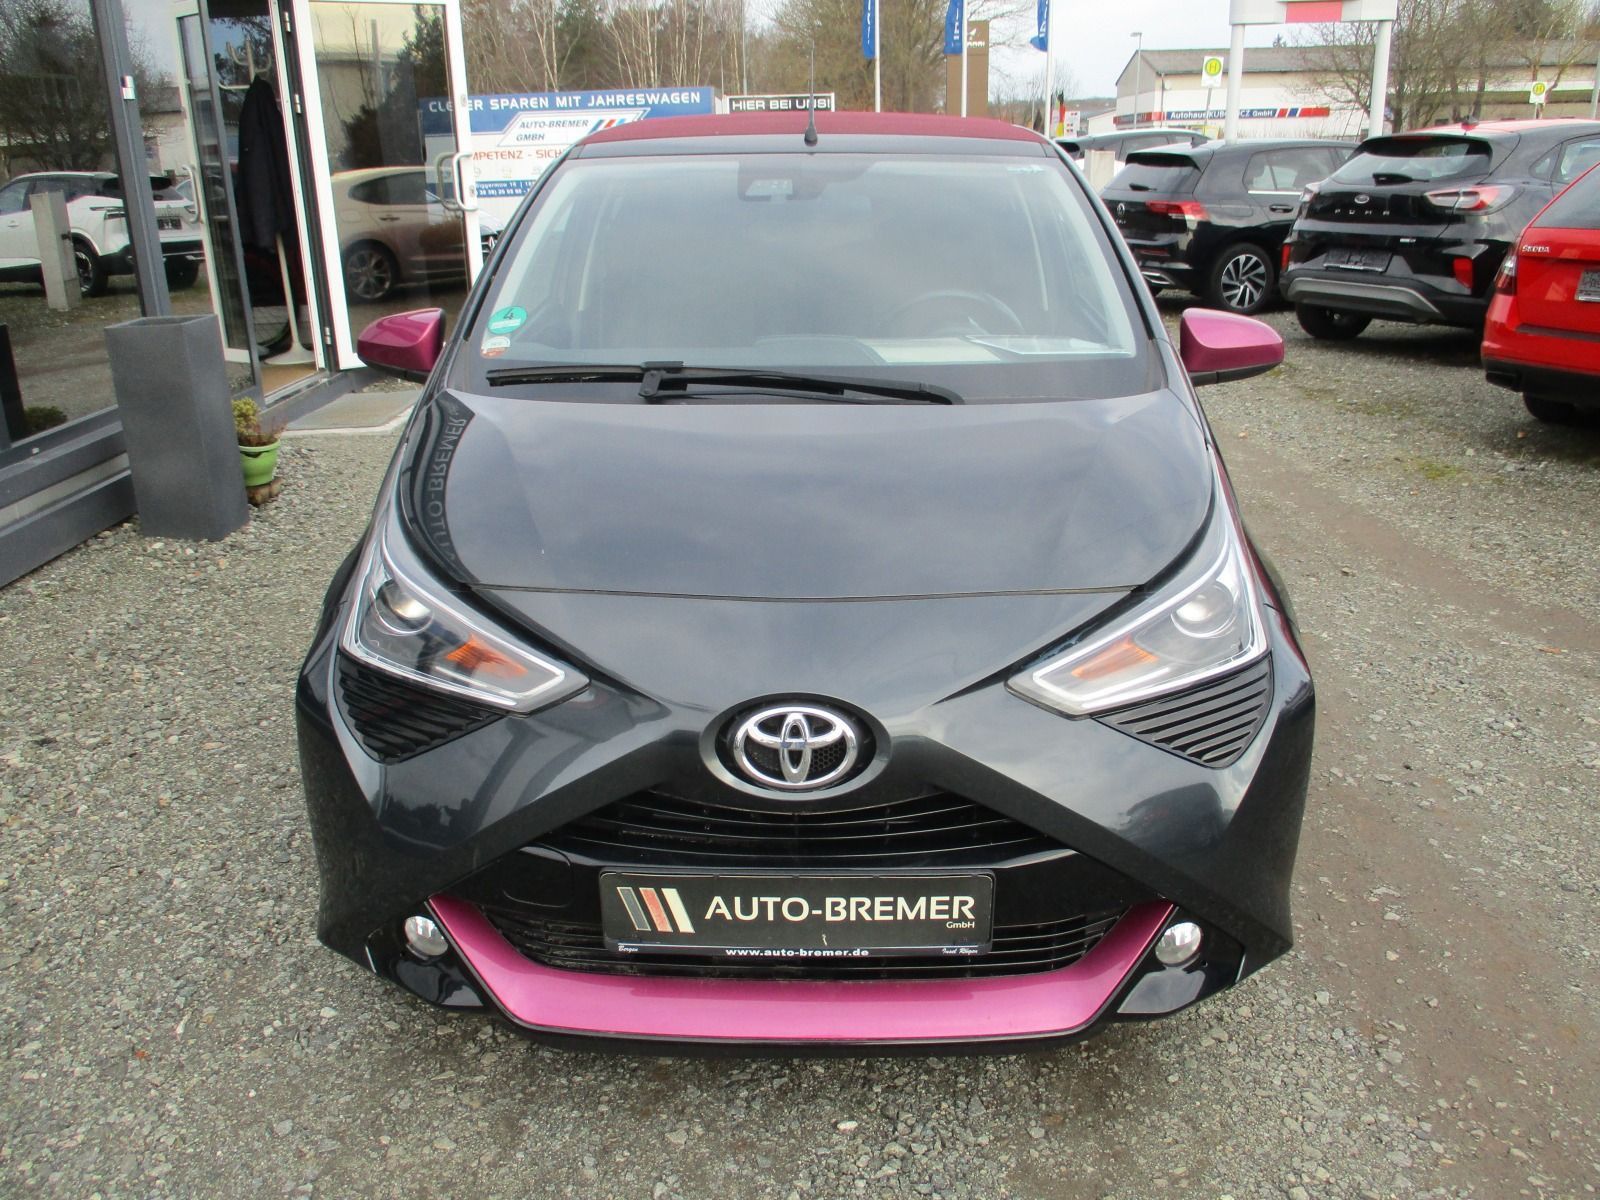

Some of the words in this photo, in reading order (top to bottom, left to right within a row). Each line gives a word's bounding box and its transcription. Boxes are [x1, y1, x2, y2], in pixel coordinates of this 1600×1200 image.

[428, 98, 483, 112] CLEER
[490, 96, 548, 110] SPAREN
[555, 96, 581, 108] MIT
[587, 91, 701, 107] JAHRESWAGEN
[732, 99, 766, 110] HIER
[769, 99, 792, 109] BEI
[1170, 110, 1207, 120] Autohaus
[1252, 109, 1273, 117] GmbH
[519, 119, 590, 129] AUTO-BREMER
[704, 895, 976, 922] AUTO-BREMER
[946, 921, 975, 929] GmbH
[725, 948, 870, 957] www.auto-bremer.de
